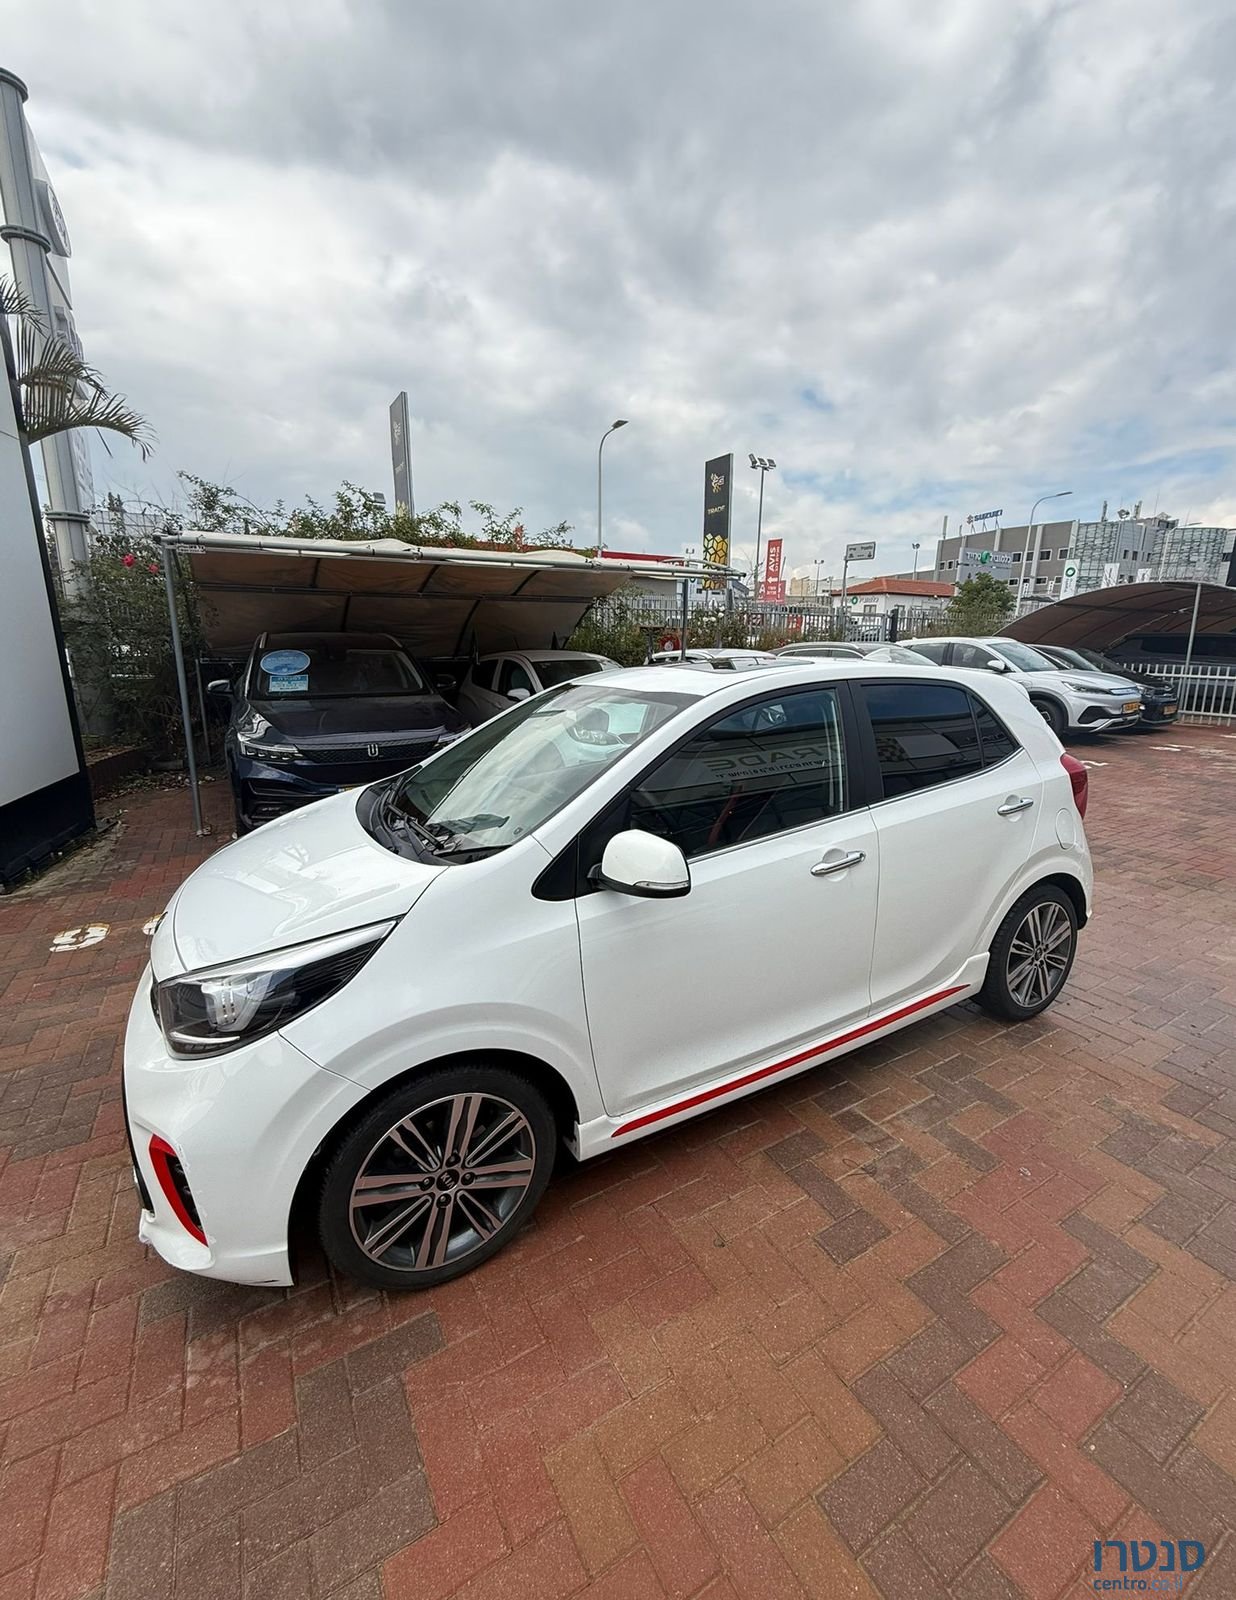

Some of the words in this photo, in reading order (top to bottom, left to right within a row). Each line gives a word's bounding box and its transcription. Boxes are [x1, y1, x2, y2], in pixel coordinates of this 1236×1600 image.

[974, 509, 1003, 521] SUZUKI
[769, 546, 777, 572] AVIS
[440, 1172, 455, 1189] KIA
